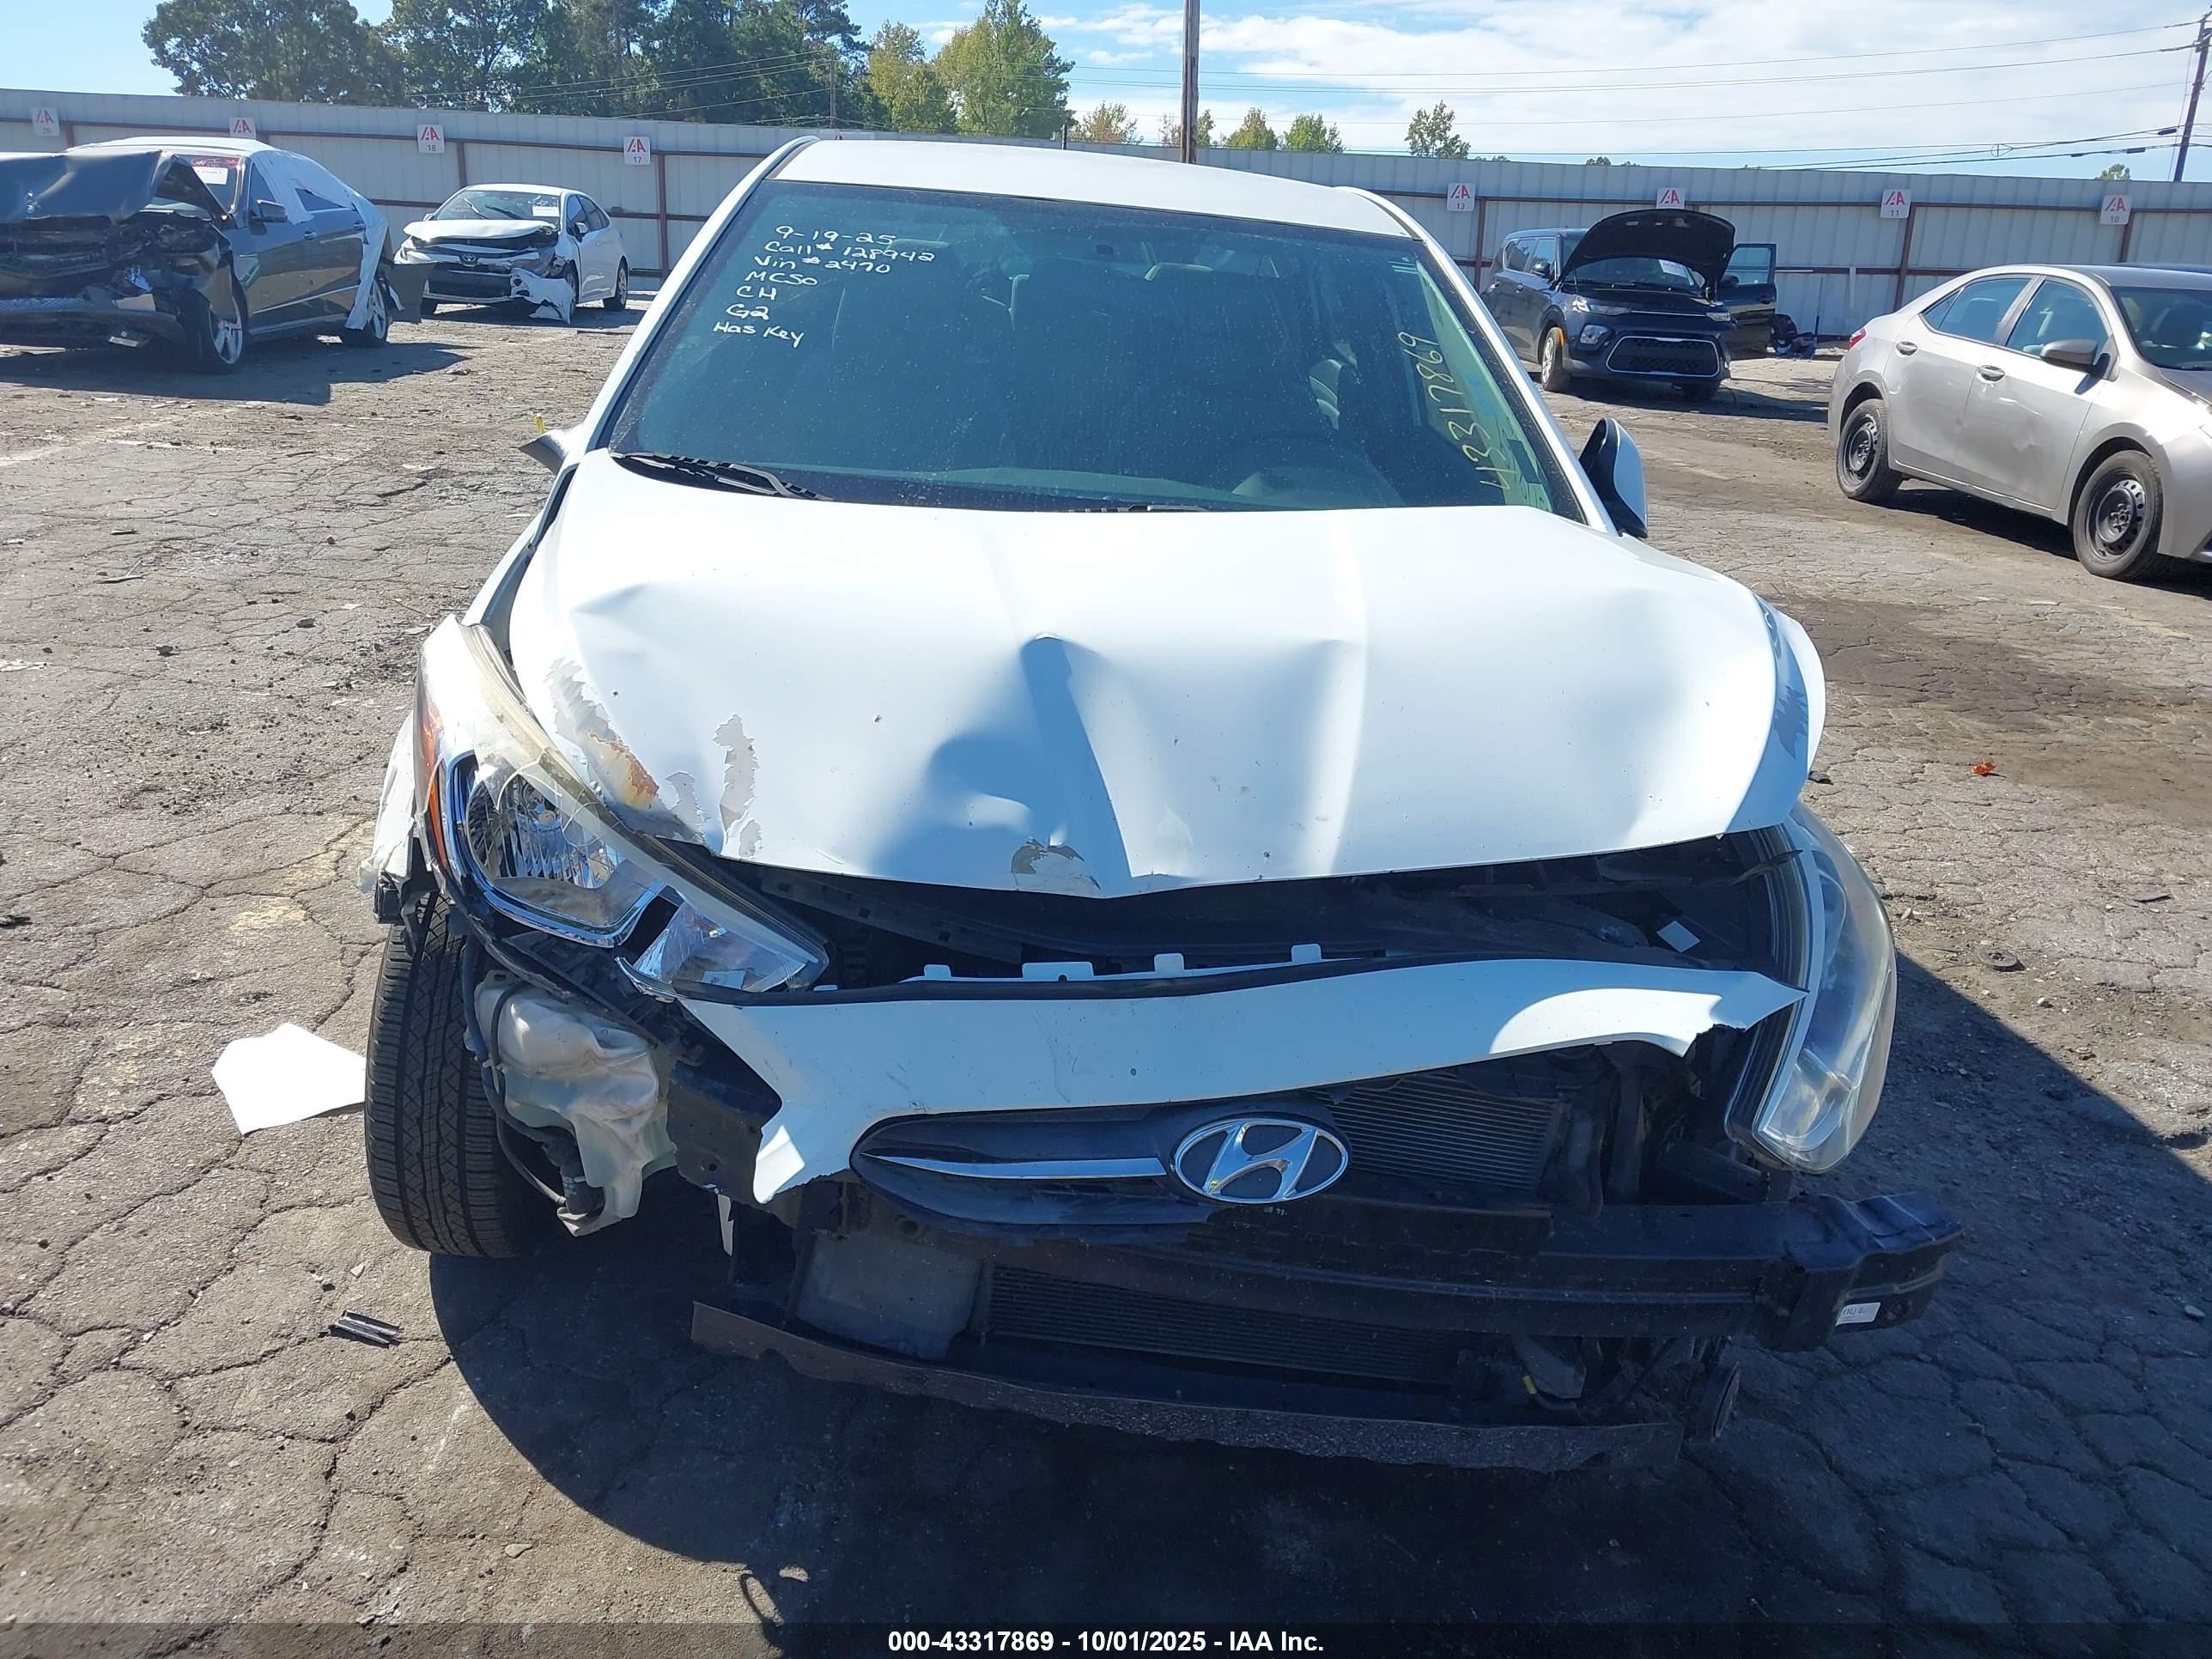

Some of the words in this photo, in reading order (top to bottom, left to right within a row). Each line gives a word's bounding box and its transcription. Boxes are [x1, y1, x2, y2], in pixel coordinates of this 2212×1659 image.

[775, 225, 896, 246] 9-19-25
[843, 246, 935, 262] 128942
[713, 321, 757, 335] Has
